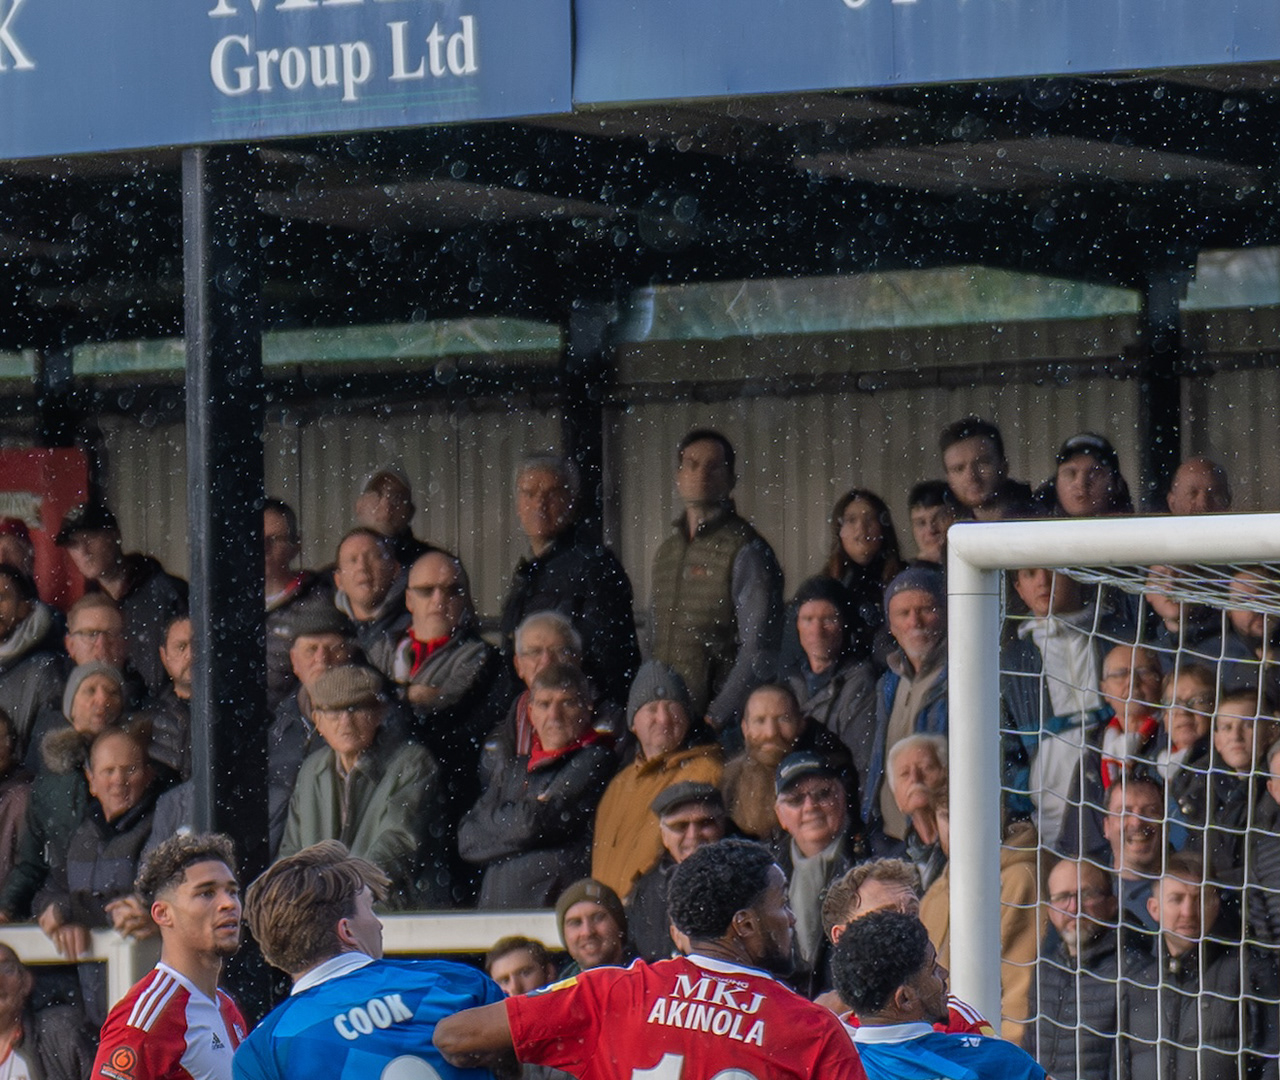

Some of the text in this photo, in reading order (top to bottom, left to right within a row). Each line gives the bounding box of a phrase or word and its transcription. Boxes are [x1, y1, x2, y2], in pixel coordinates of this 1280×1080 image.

[211, 16, 477, 101] Group Ltd
[333, 993, 414, 1040] COOK
[669, 974, 767, 1016] MKJ
[647, 997, 766, 1047] AKINOLA
